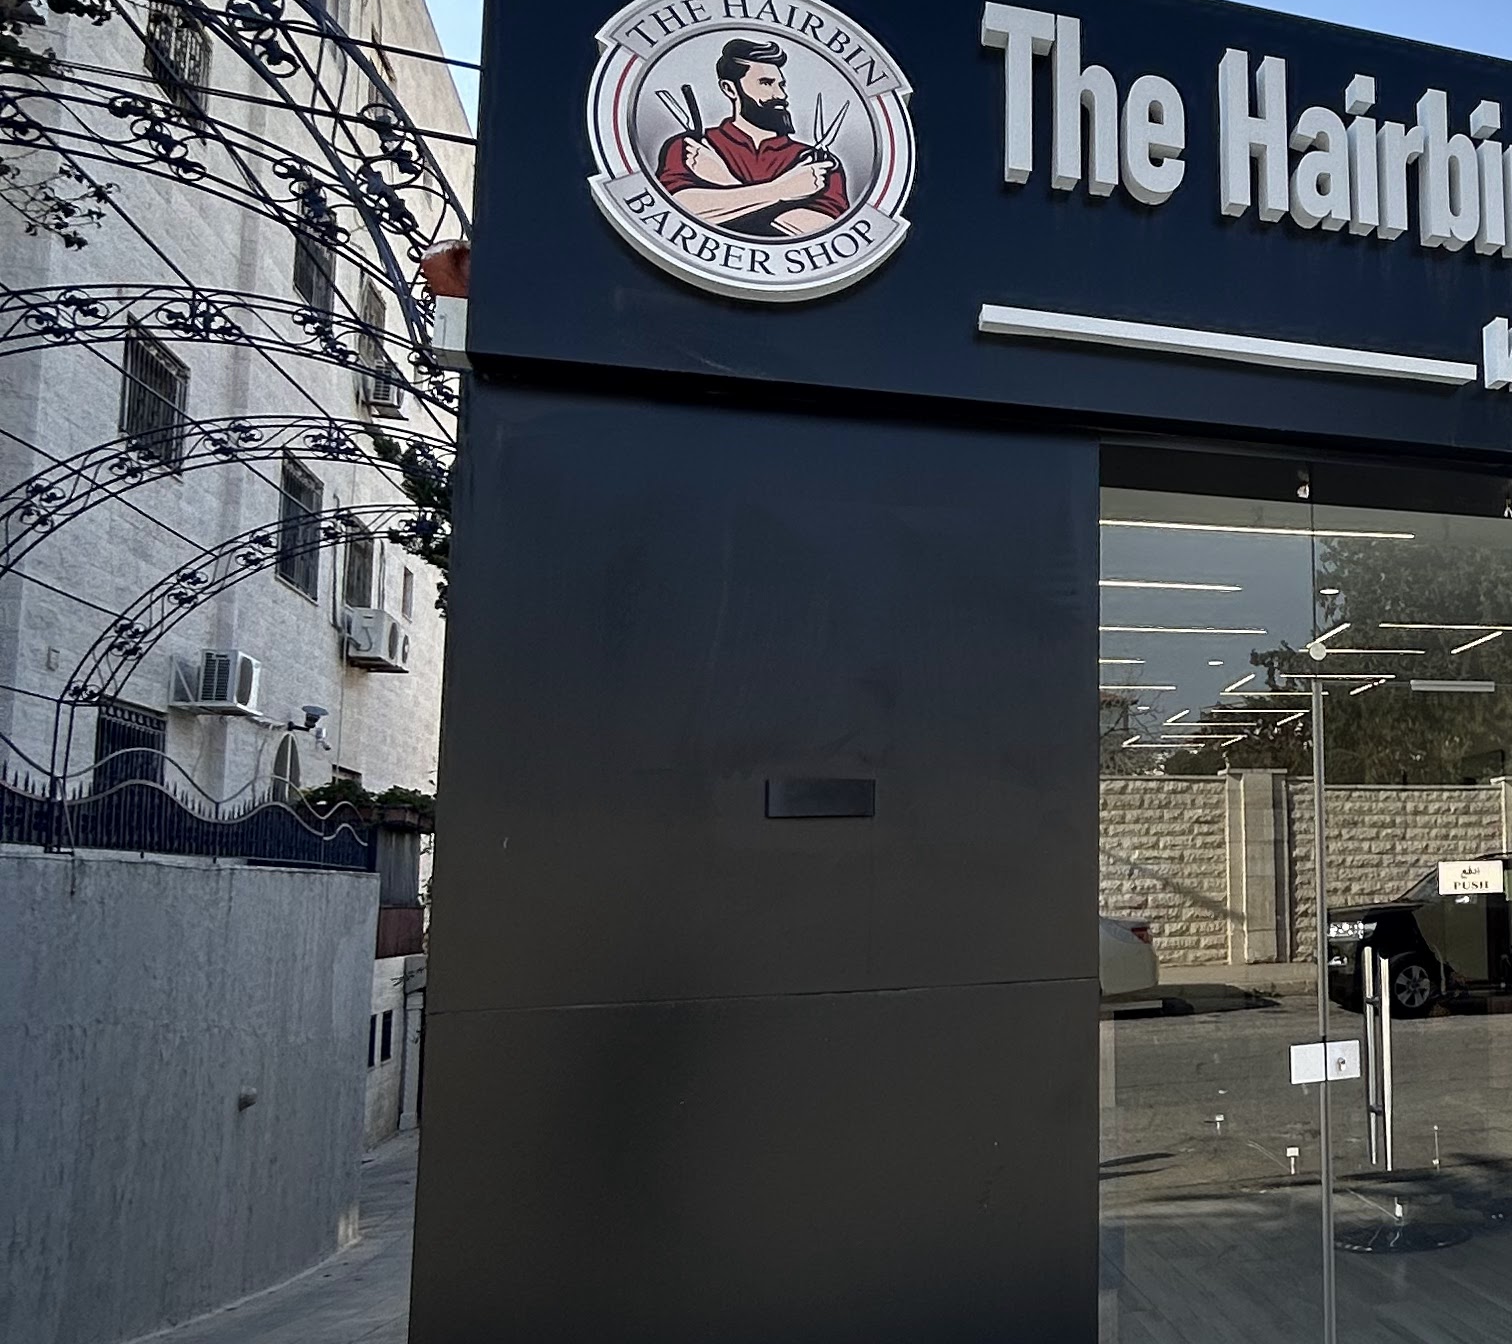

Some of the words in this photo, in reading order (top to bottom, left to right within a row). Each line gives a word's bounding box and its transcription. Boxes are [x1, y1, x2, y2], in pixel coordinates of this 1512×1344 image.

[981, 1, 1186, 205] The
[623, 187, 776, 276] BARBER
[786, 219, 877, 274] SHOP
[1453, 880, 1489, 890] PUSH
